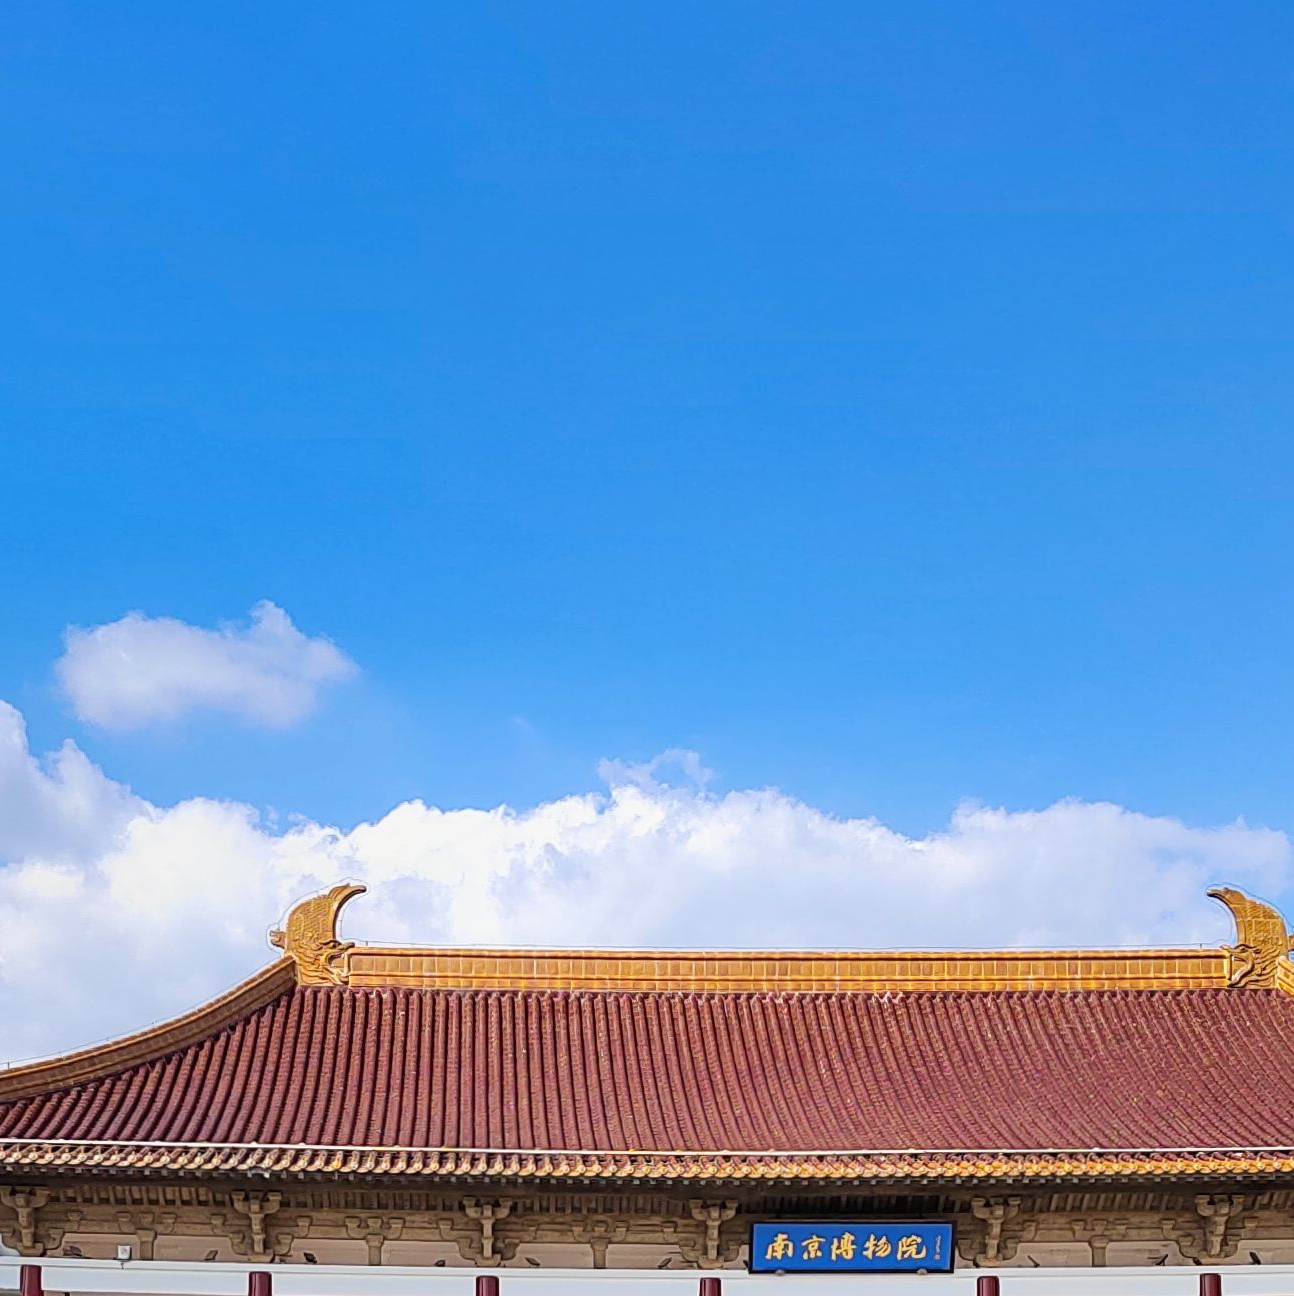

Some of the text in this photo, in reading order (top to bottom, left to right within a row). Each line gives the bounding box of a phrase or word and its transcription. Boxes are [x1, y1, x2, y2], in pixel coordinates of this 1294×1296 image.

[765, 1232, 927, 1261] 南京博物院
